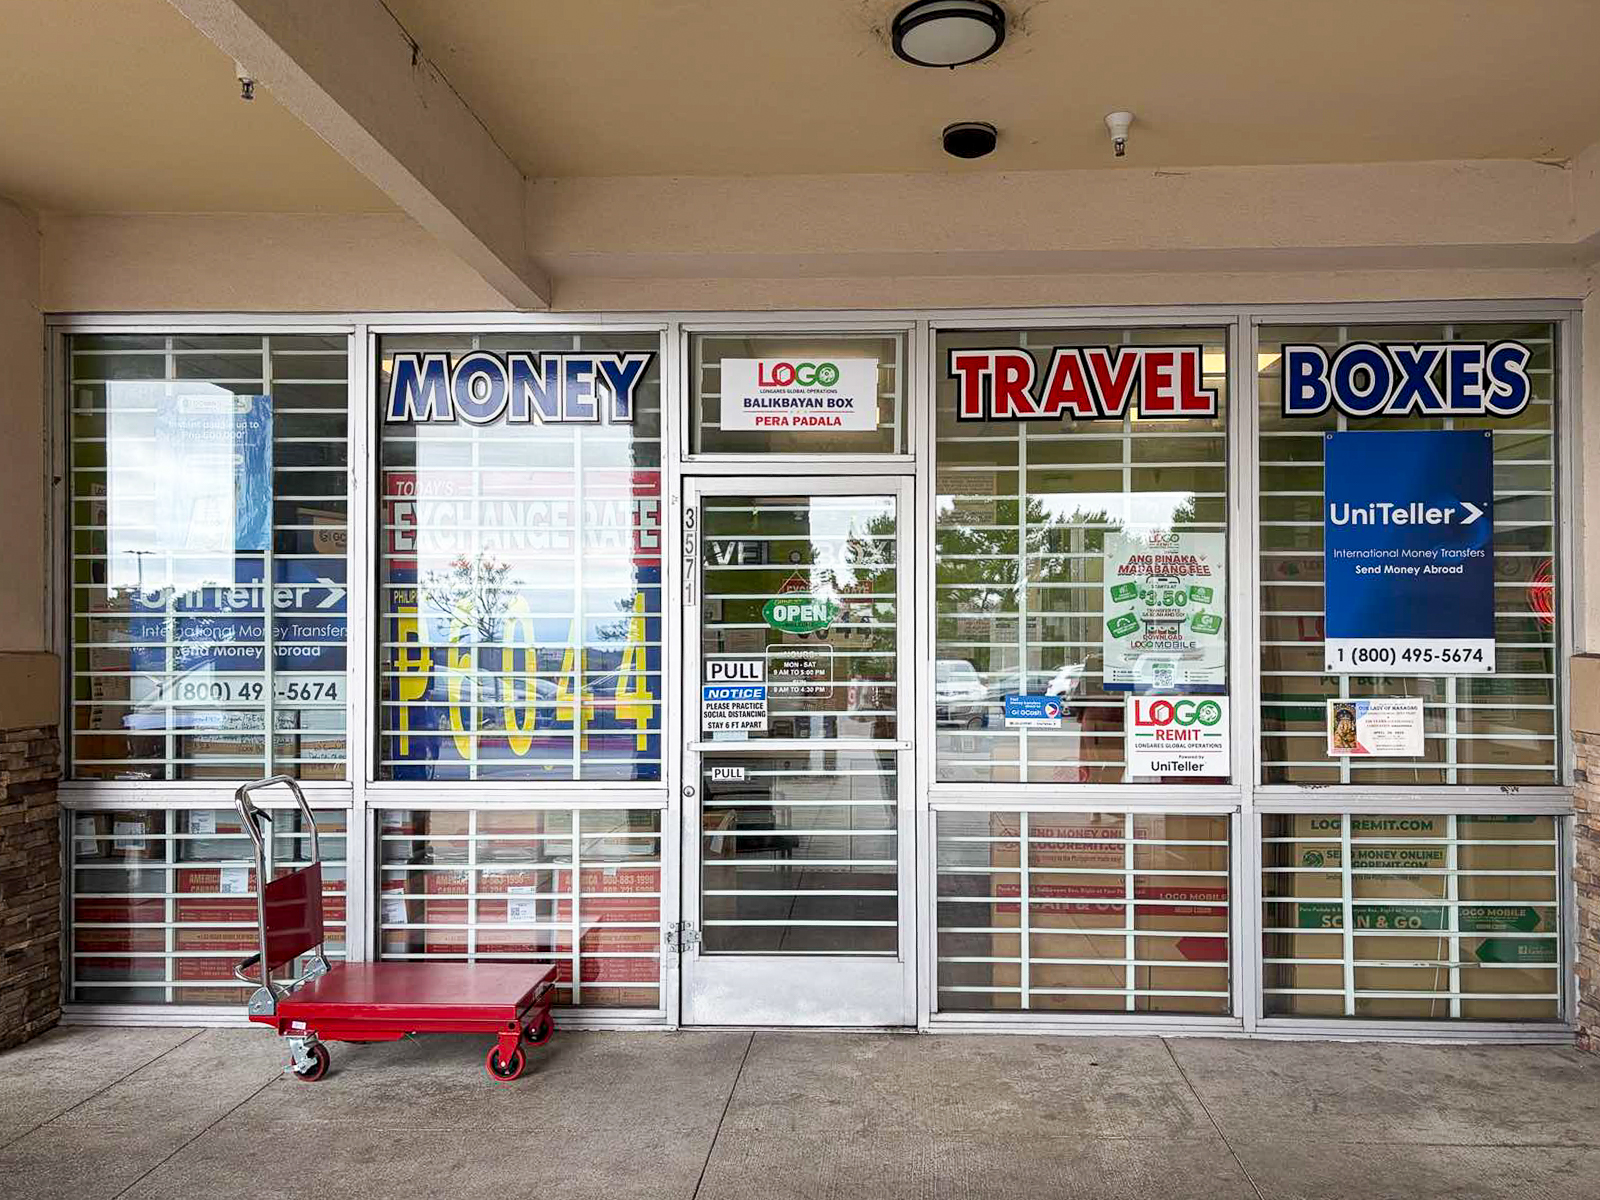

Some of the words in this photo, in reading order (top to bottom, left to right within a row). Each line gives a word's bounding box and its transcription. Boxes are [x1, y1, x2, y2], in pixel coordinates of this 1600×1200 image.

[758, 362, 840, 387] LOGO
[1281, 340, 1533, 418] BOXES
[386, 351, 656, 424] MONEY
[948, 345, 1218, 421] TRAVEL
[743, 398, 823, 408] BALIKBAYAN
[827, 398, 854, 408] BOX
[755, 416, 789, 426] PERA
[793, 416, 842, 426] PADALA
[395, 480, 454, 496] TODAY'S
[1329, 502, 1456, 525] UniTeller
[393, 500, 569, 552] EXCHANGE
[582, 500, 659, 551] RATE
[1128, 554, 1153, 565] ANG
[1333, 548, 1399, 559] International
[1401, 548, 1439, 562] Money
[1440, 548, 1486, 559] Transfers
[1188, 565, 1212, 576] FEE
[1355, 565, 1382, 574] Send
[1384, 565, 1420, 577] Money
[1423, 565, 1464, 574] Abroad
[773, 604, 828, 622] OPEN
[142, 625, 235, 642] Inteational
[238, 624, 287, 644] Moey
[1154, 641, 1197, 649] MOBILE
[1337, 648, 1344, 663] 1
[1351, 647, 1396, 665] (800)
[1401, 648, 1484, 663] 495-5674
[711, 662, 759, 679] PULL
[708, 688, 763, 699] NOTICE
[705, 702, 730, 710] PLEASE
[732, 702, 764, 710] PRACTICE
[703, 710, 727, 718] SOCIAL
[728, 710, 767, 718] DISTANCING
[1134, 700, 1222, 727] LOGO
[707, 721, 723, 729] STAY
[725, 721, 730, 729] 6
[731, 721, 739, 729] FT
[741, 721, 762, 729] APART
[1156, 729, 1202, 741] REMIT
[1151, 761, 1205, 772] UniTeller
[714, 768, 743, 779] PULL
[1311, 819, 1433, 831] LOGREMIT.COM
[1030, 827, 1053, 838] END
[1057, 828, 1098, 839] MONEY
[1327, 850, 1355, 859] SE
[1358, 850, 1399, 859] MONEY
[1400, 850, 1443, 860] ONLINE!
[189, 874, 221, 885] AMERIC
[1487, 908, 1526, 917] MOBILE
[1321, 914, 1370, 928] SCN
[1376, 915, 1388, 928] &
[1394, 915, 1422, 928] GO
